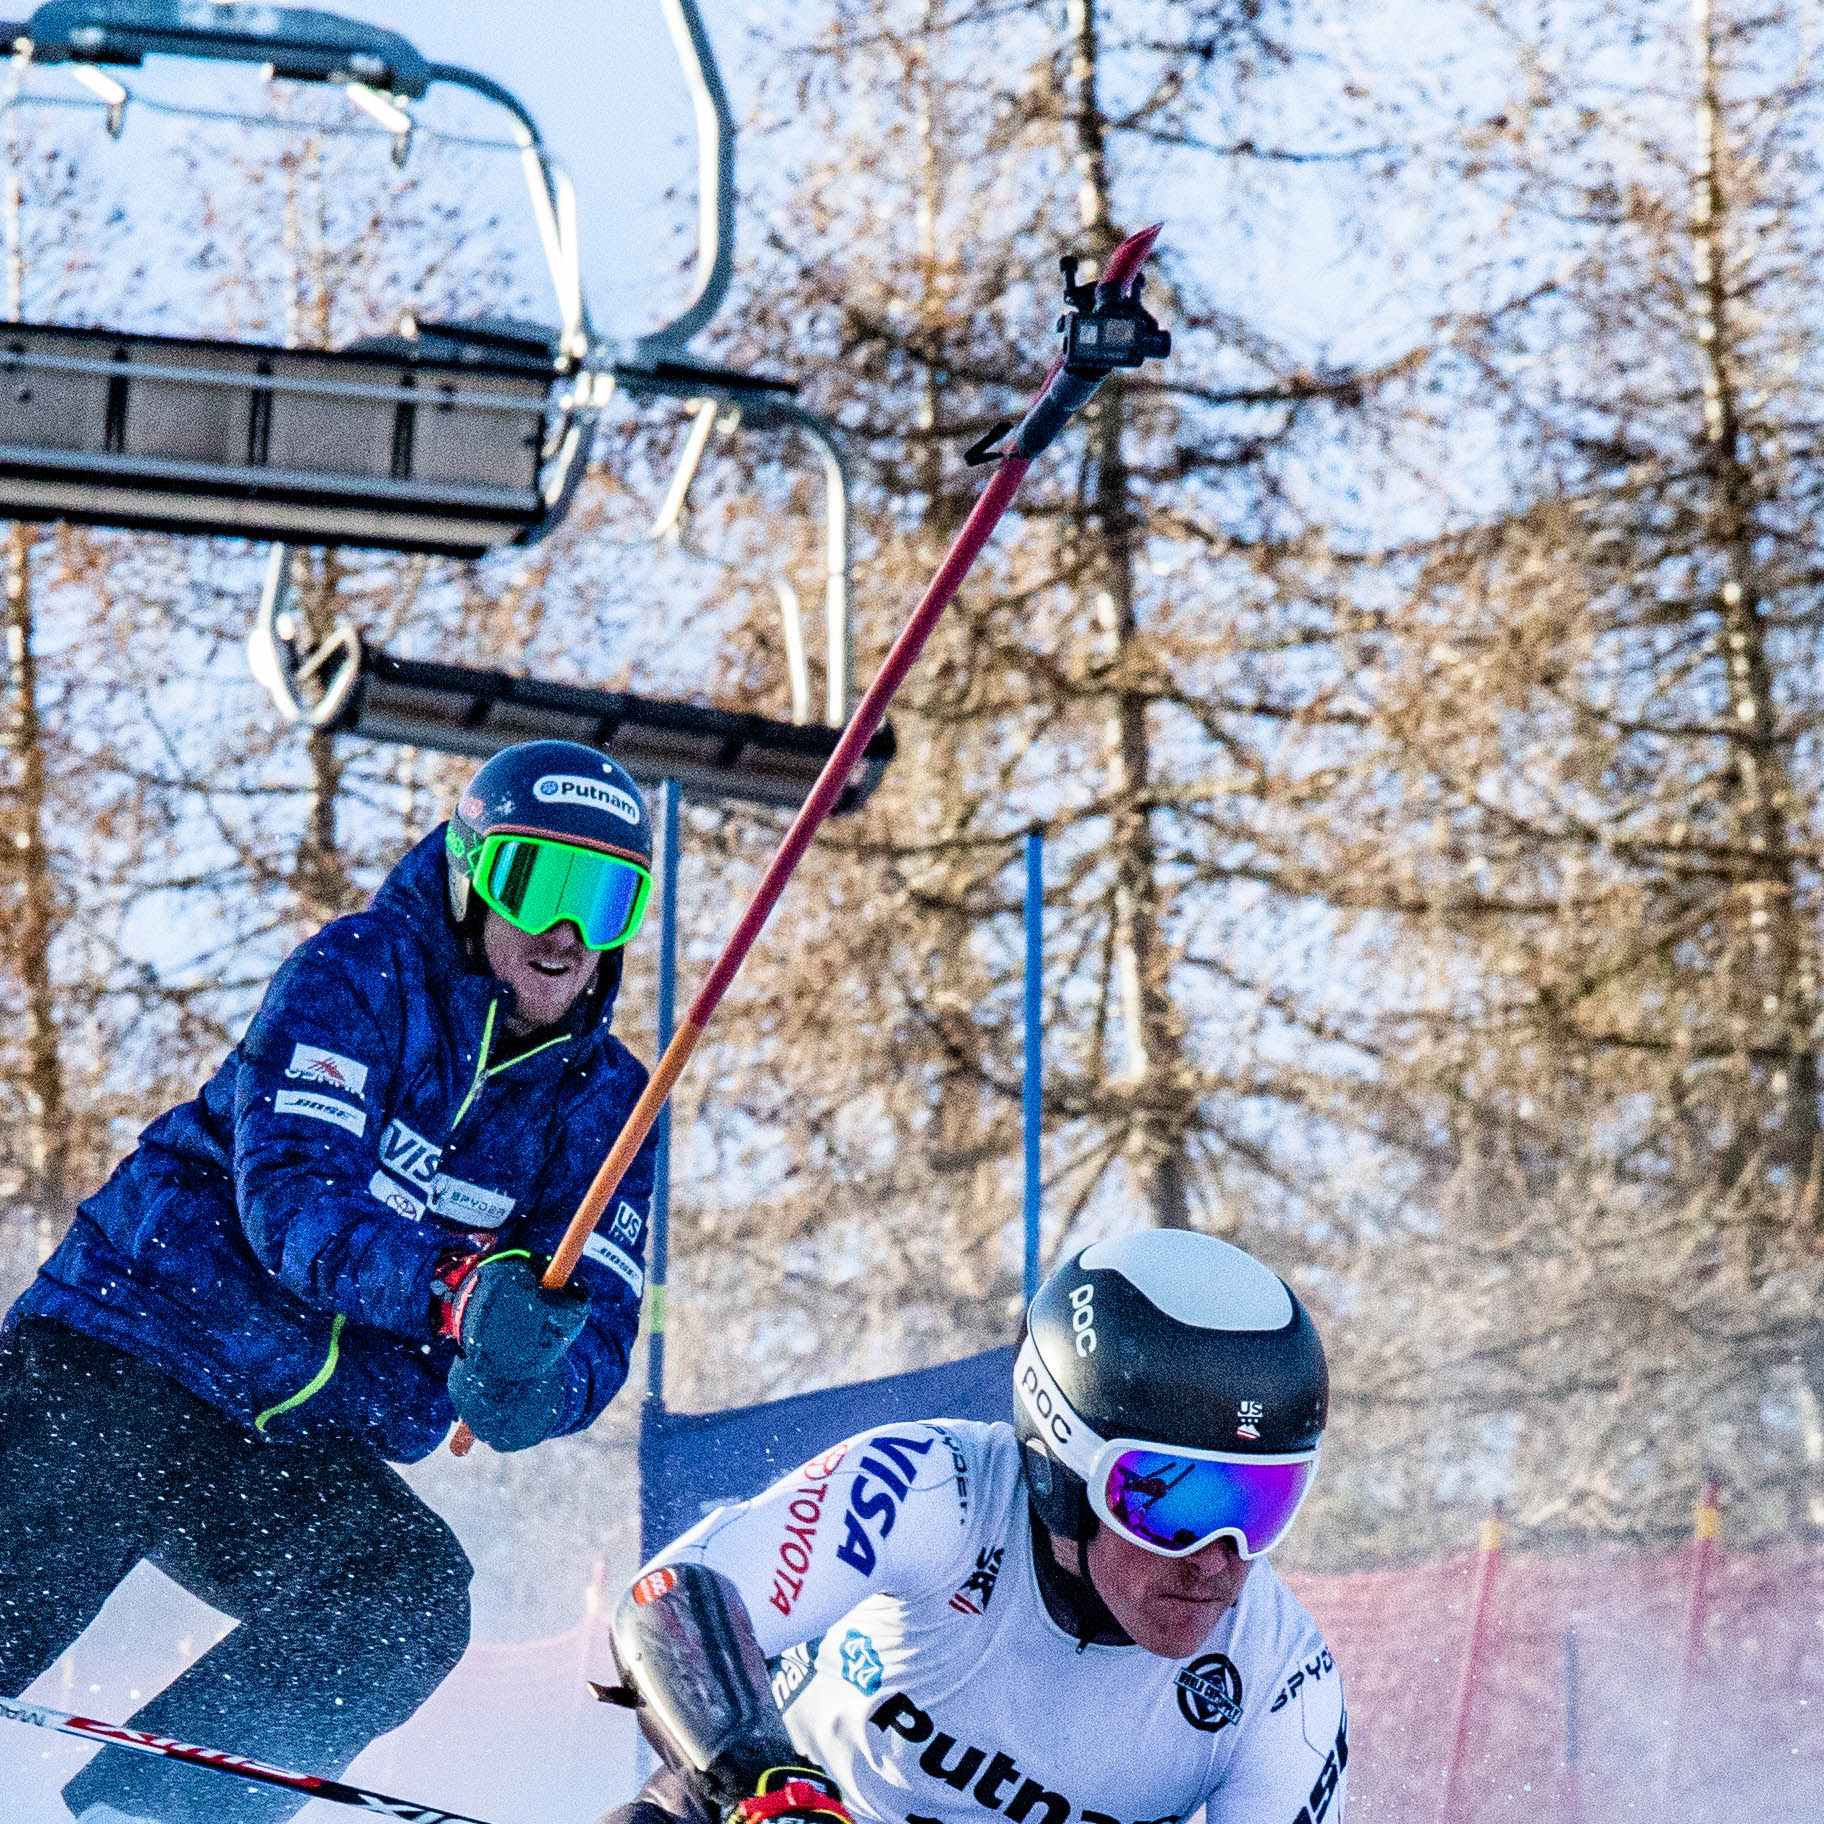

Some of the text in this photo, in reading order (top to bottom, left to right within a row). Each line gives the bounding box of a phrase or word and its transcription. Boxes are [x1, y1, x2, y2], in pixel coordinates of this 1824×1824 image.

[561, 781, 637, 819] Putnam
[383, 1126, 442, 1184] VIS
[616, 1205, 641, 1239] US
[1069, 1283, 1098, 1358] POC
[1021, 1364, 1073, 1445] POC
[836, 1436, 935, 1578] VISA
[768, 1482, 830, 1618] TOYOTA
